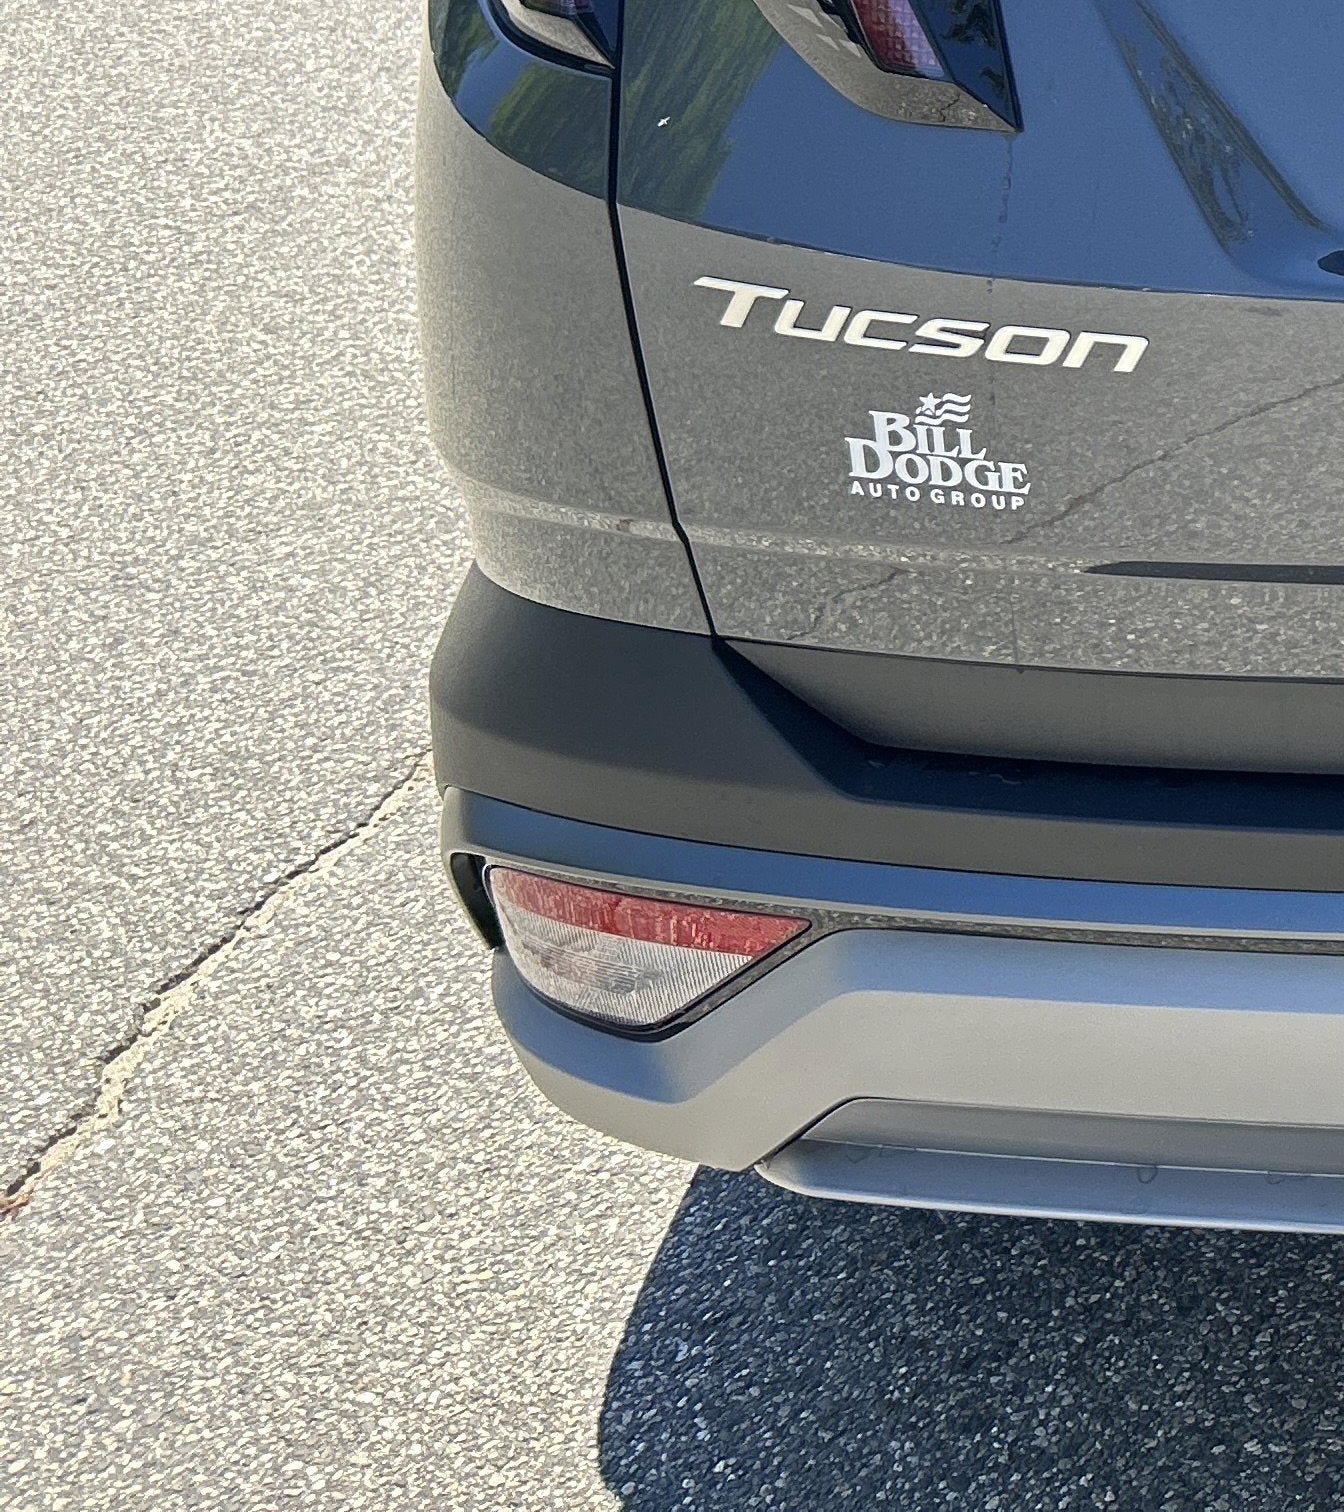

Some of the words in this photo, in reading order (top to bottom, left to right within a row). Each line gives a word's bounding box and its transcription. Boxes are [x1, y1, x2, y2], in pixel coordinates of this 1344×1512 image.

[868, 410, 987, 460] BILL
[844, 437, 1031, 495] DODGE
[851, 480, 921, 501] AUTO
[930, 488, 1025, 510] GROUP
